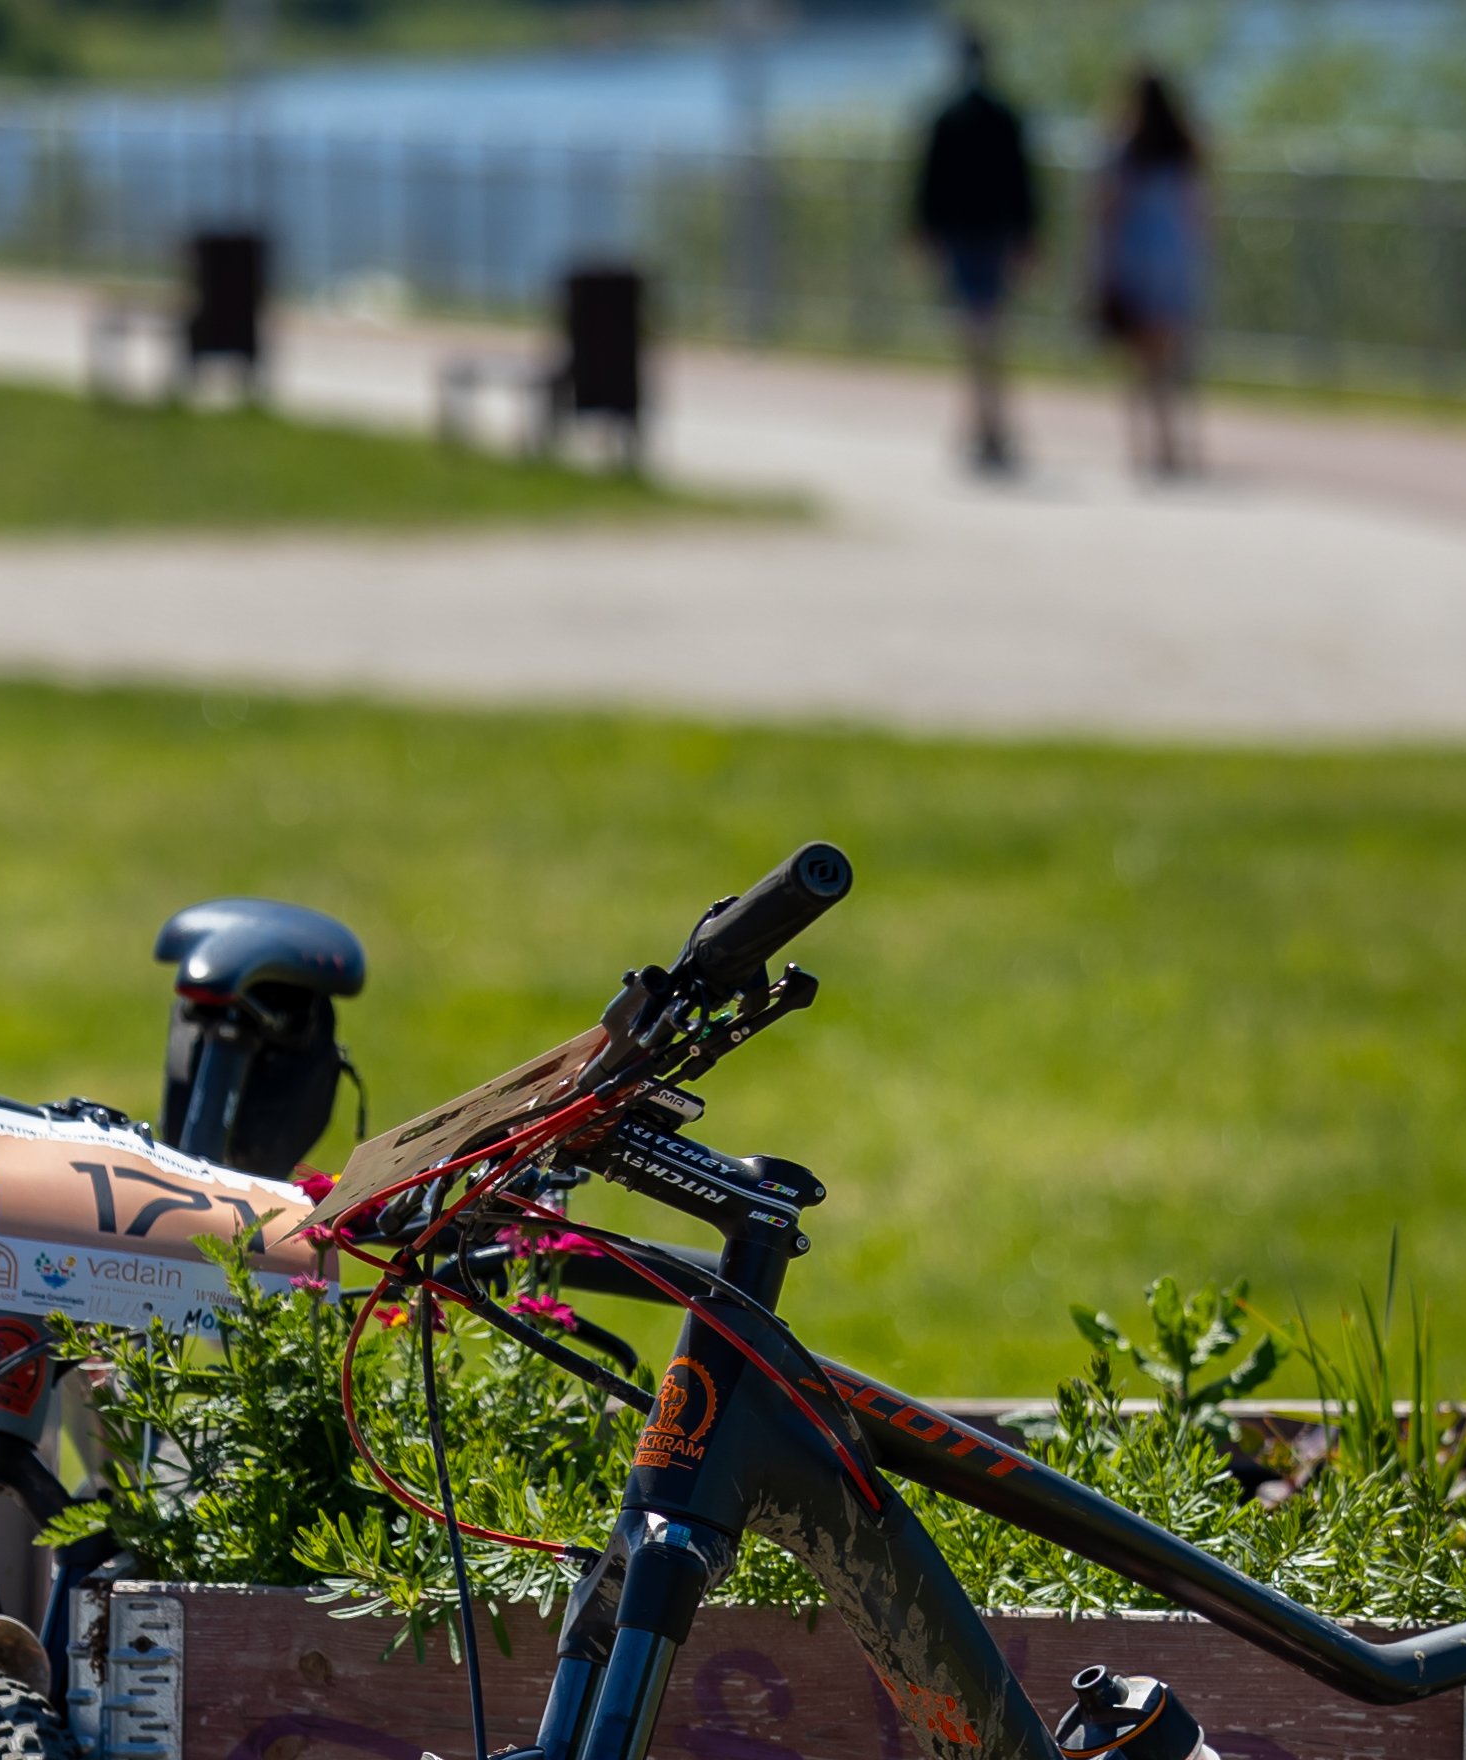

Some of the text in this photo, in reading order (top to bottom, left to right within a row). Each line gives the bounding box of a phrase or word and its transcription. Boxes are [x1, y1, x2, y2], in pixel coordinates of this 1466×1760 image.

[623, 1123, 737, 1175] RITCHEY
[87, 1256, 183, 1290] vadain
[799, 1364, 1034, 1478] SCOTT
[639, 1453, 666, 1465] TEAM
